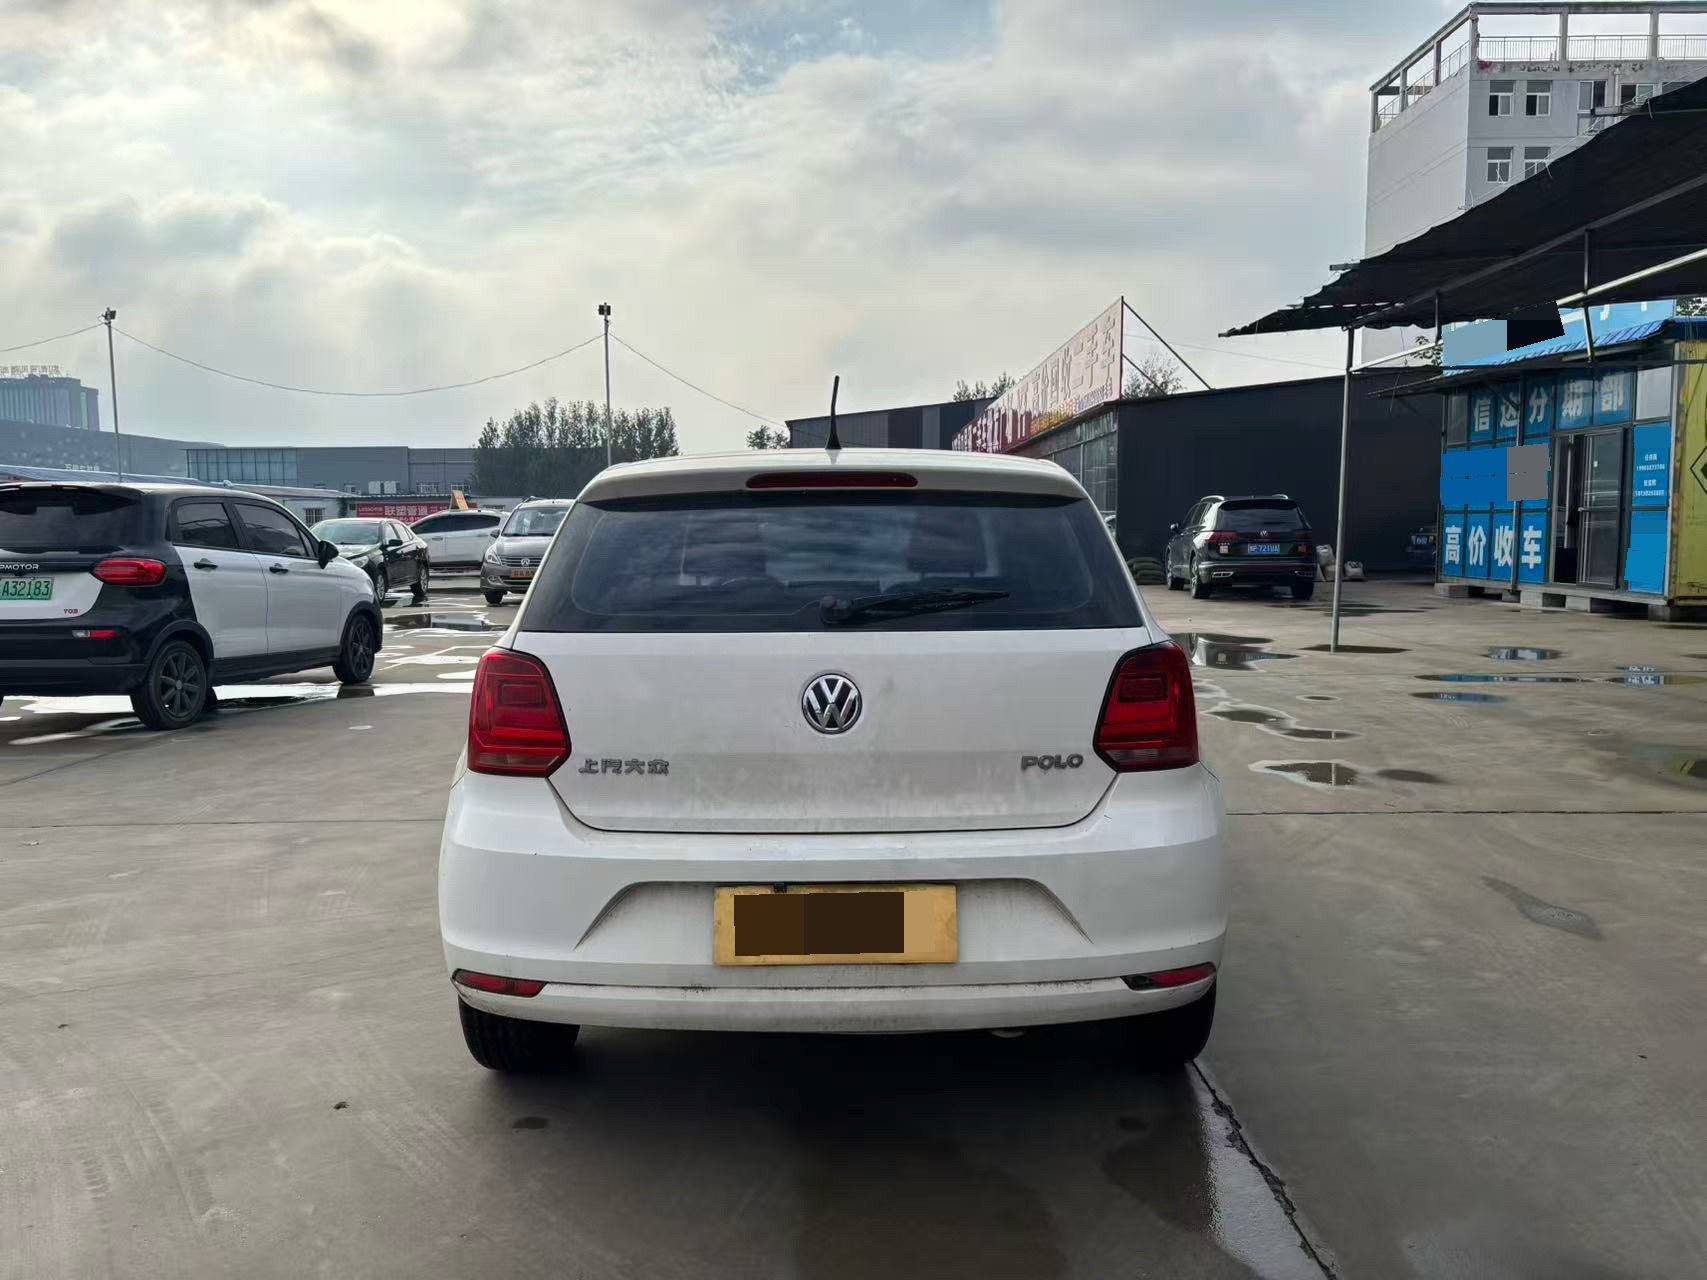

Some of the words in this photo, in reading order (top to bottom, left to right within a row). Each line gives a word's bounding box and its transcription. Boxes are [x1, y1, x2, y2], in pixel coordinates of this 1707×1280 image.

[1445, 525, 1542, 569] 高价收车
[578, 758, 670, 776] 上汽大众
[1021, 753, 1084, 771] POLO
